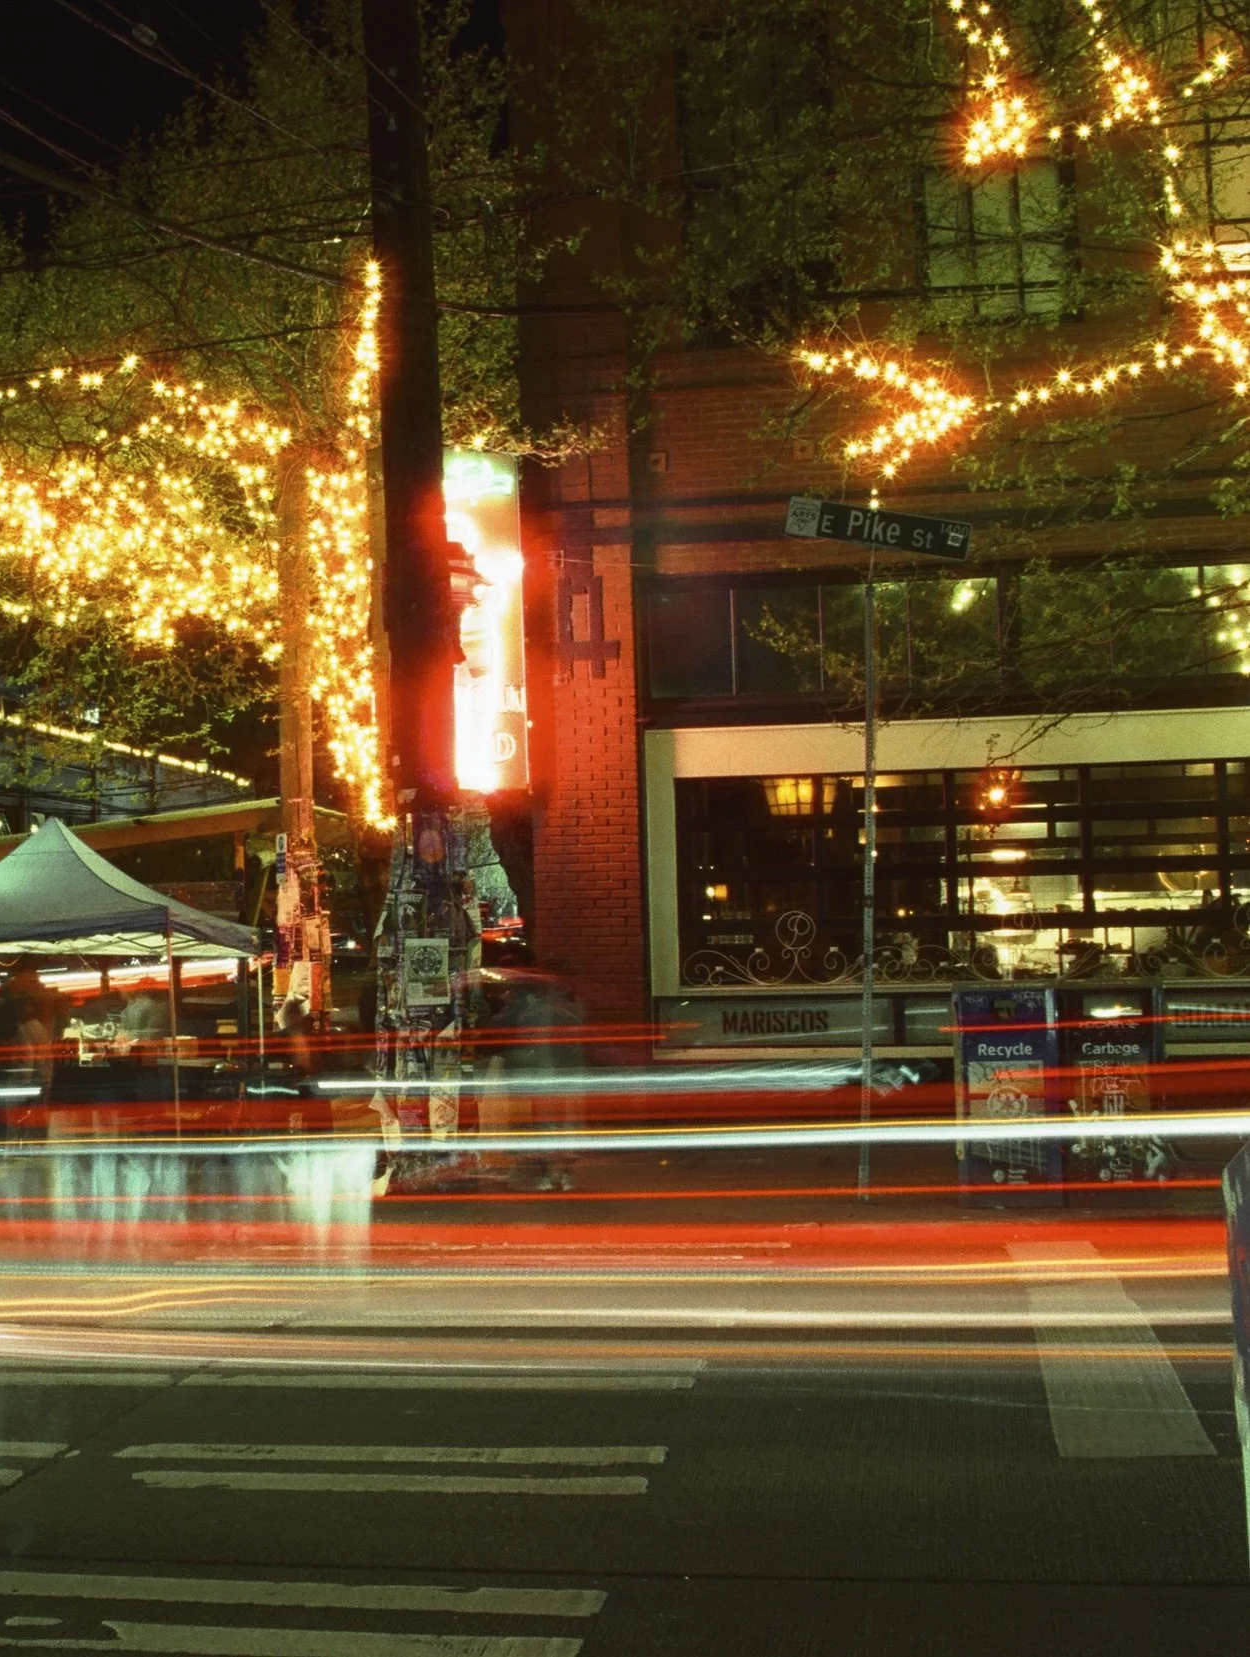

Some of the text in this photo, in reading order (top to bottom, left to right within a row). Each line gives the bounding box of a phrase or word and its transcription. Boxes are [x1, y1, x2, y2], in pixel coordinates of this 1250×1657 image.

[821, 509, 934, 549] E Pike St
[722, 1010, 830, 1035] MARISCOS
[977, 1042, 1034, 1059] Recycle
